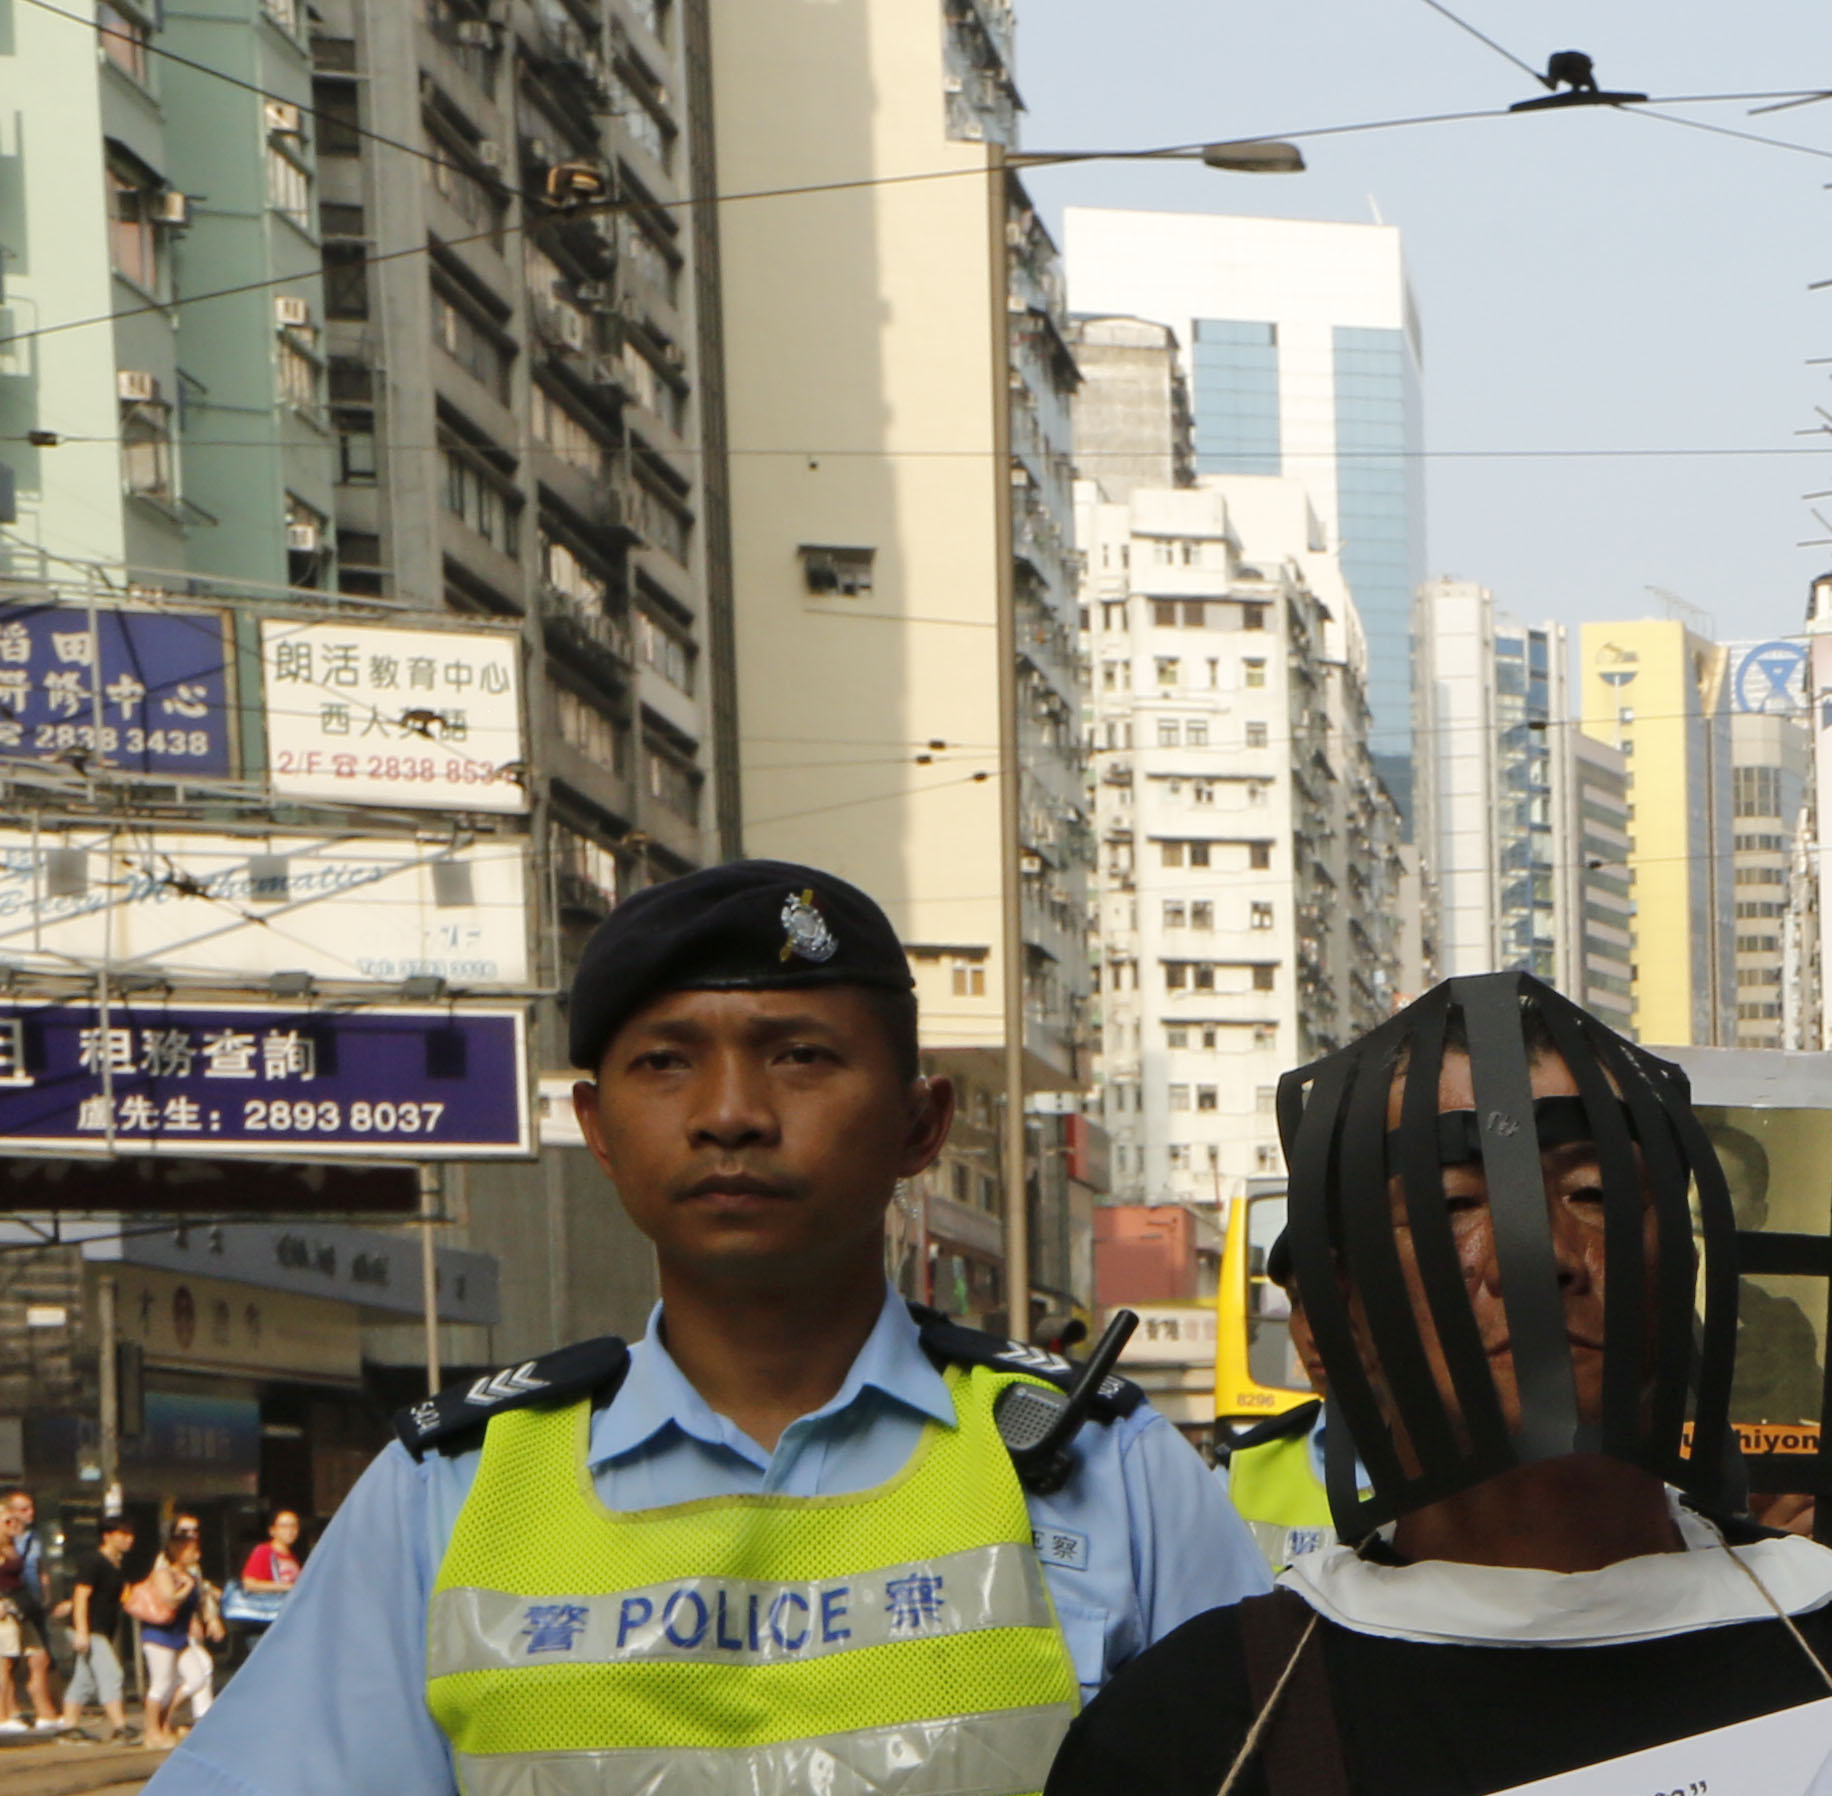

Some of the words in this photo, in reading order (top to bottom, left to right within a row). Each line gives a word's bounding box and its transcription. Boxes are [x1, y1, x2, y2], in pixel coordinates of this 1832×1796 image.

[275, 640, 510, 694] 朗活教育中心
[35, 723, 119, 752] 2838
[126, 728, 208, 756] 3438
[278, 751, 322, 775] 2/F
[368, 756, 435, 782] 2838
[122, 864, 384, 905] Mhematics
[78, 1027, 316, 1082] 租務查詢
[244, 1100, 341, 1132] 2893
[349, 1102, 446, 1133] 8037
[521, 1603, 590, 1655] 警
[615, 1586, 852, 1652] POLICE
[885, 1573, 944, 1630] 察
